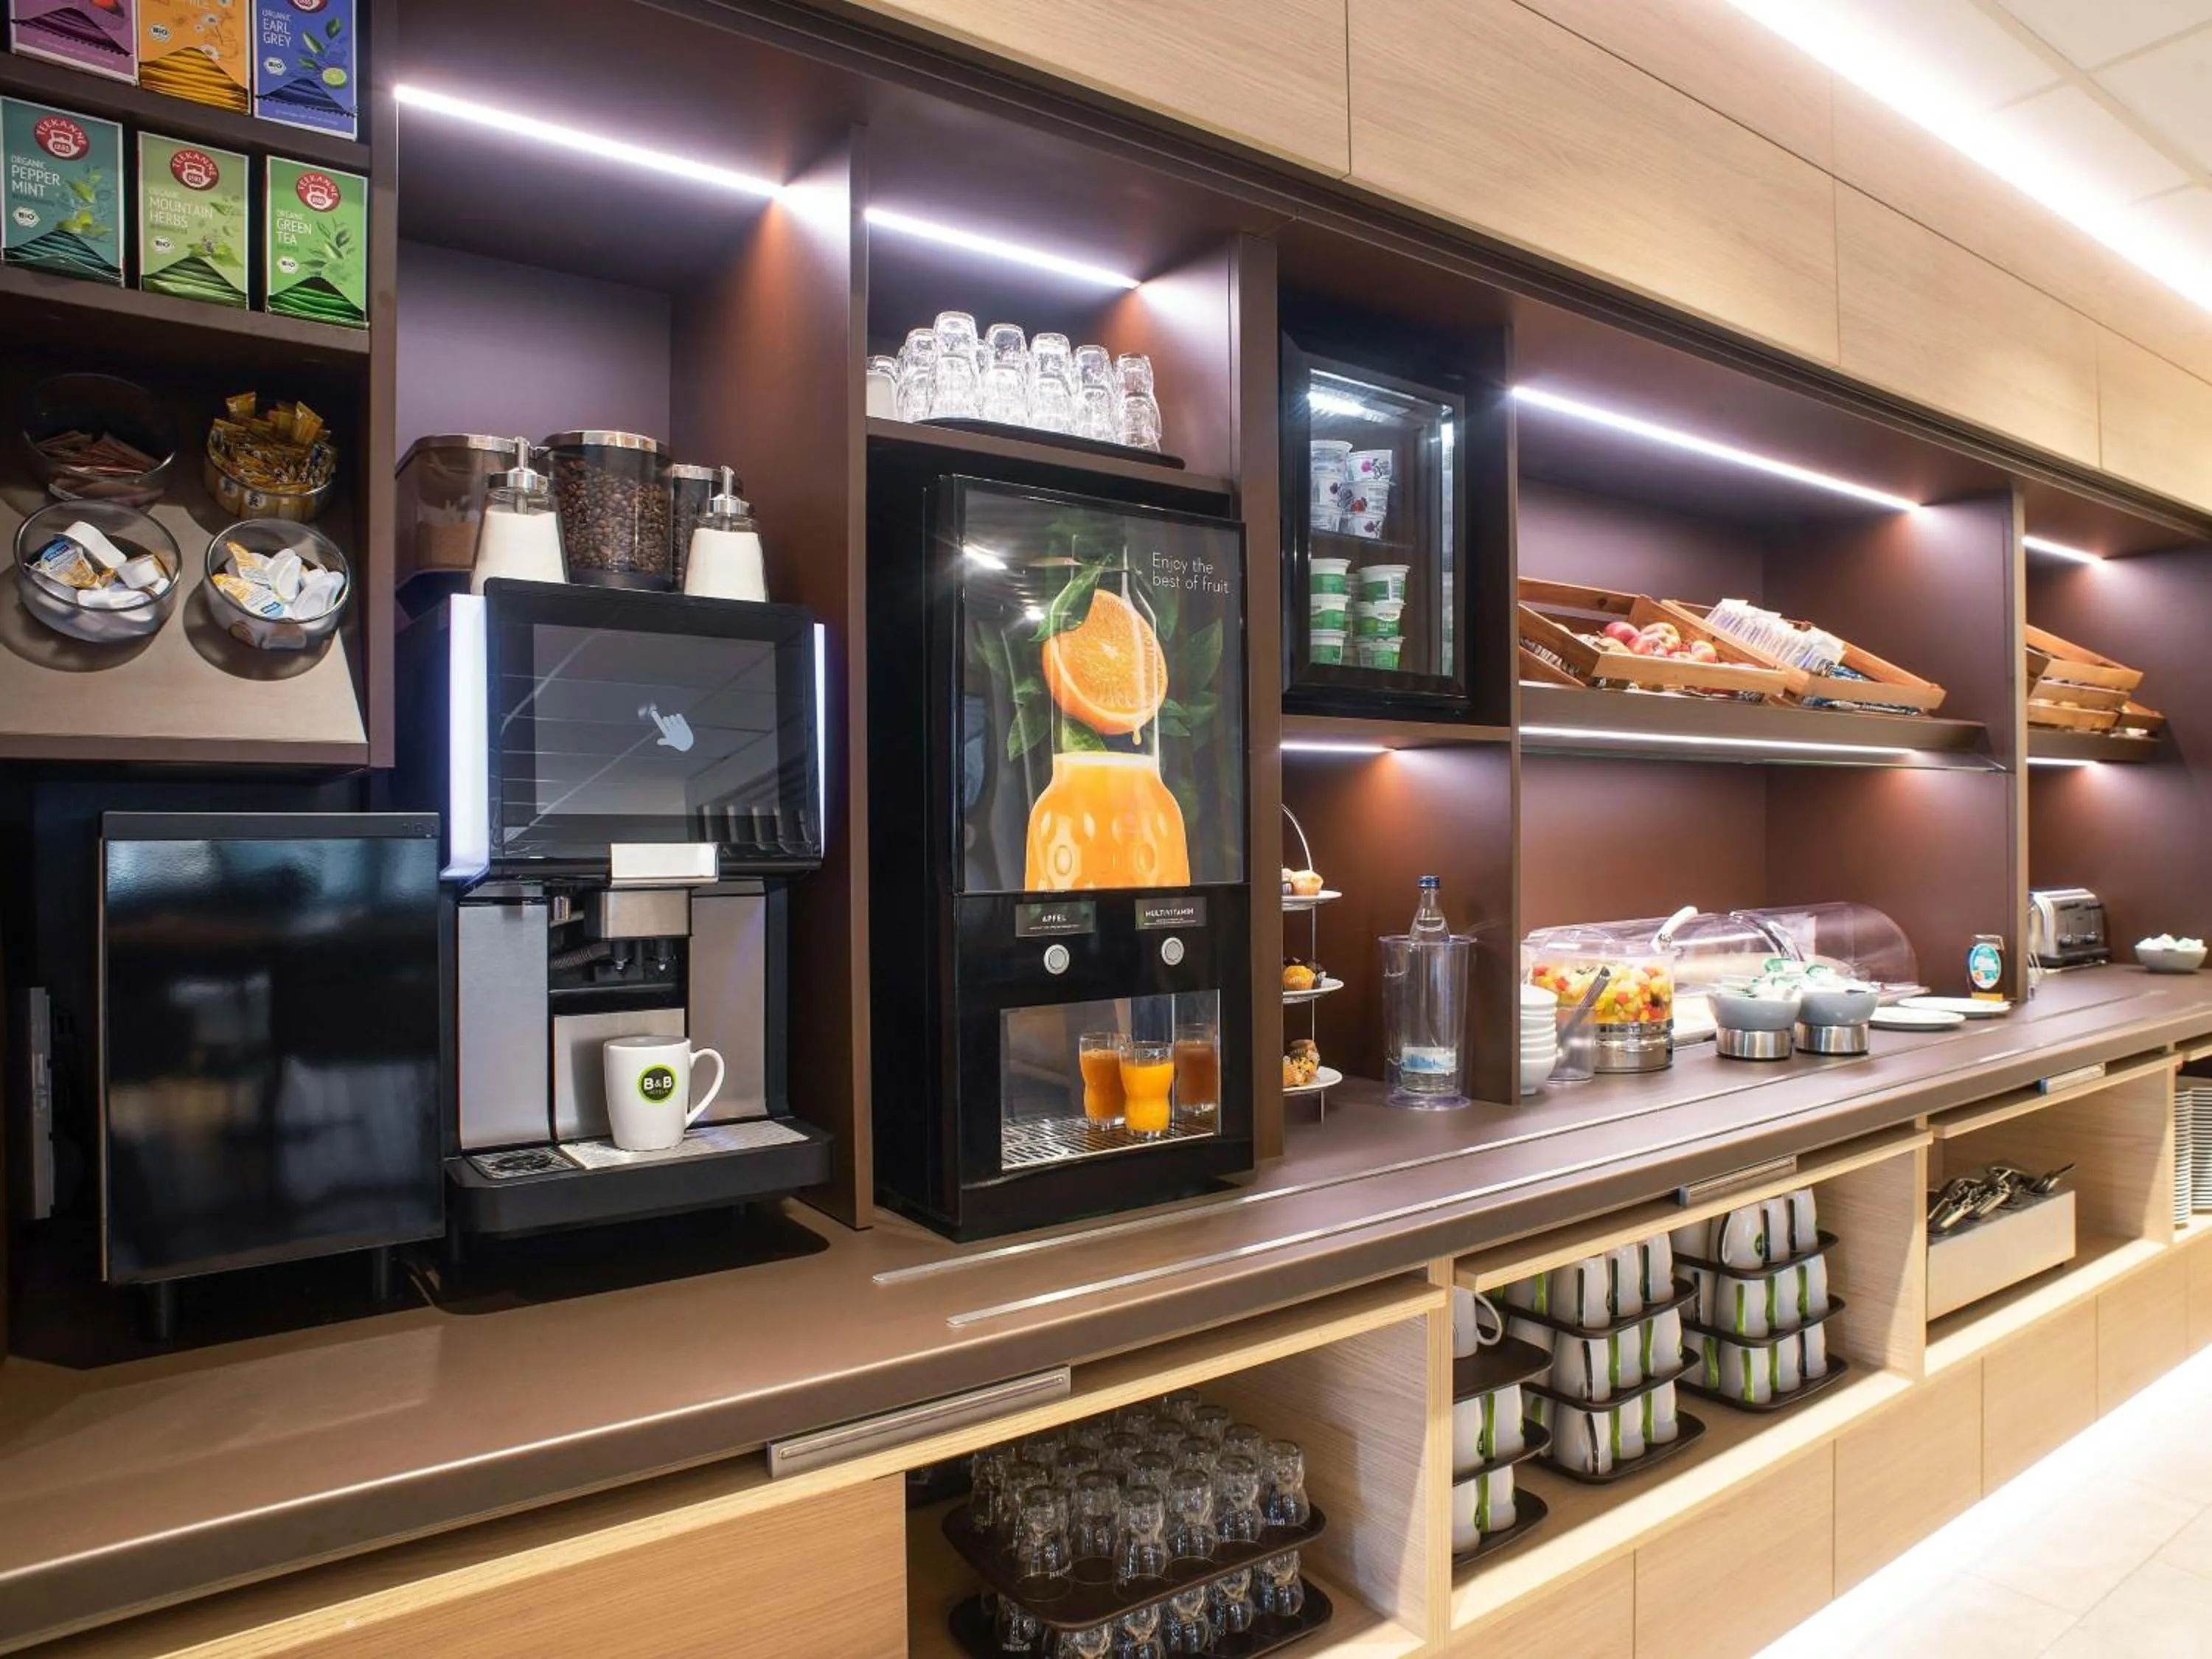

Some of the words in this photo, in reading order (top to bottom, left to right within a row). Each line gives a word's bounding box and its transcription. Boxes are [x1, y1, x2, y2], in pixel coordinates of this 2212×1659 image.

[262, 18, 291, 35] EARL
[262, 32, 292, 48] GREY
[37, 118, 87, 147] TEEKANNE
[11, 155, 47, 170] ORGANIC
[172, 152, 218, 176] TEEKANNE
[11, 164, 61, 187] PEPPER
[12, 179, 46, 198] MINT
[150, 196, 214, 220] MOUNTAIN
[150, 210, 189, 228] HERBS
[276, 218, 312, 235] GREEN
[276, 231, 298, 246] TEA
[1152, 551, 1188, 574] Enjoy
[1192, 557, 1214, 574] the
[1152, 568, 1180, 588] best
[1185, 574, 1198, 590] of
[1203, 576, 1230, 594] fruit
[644, 1076, 672, 1091] B&B
